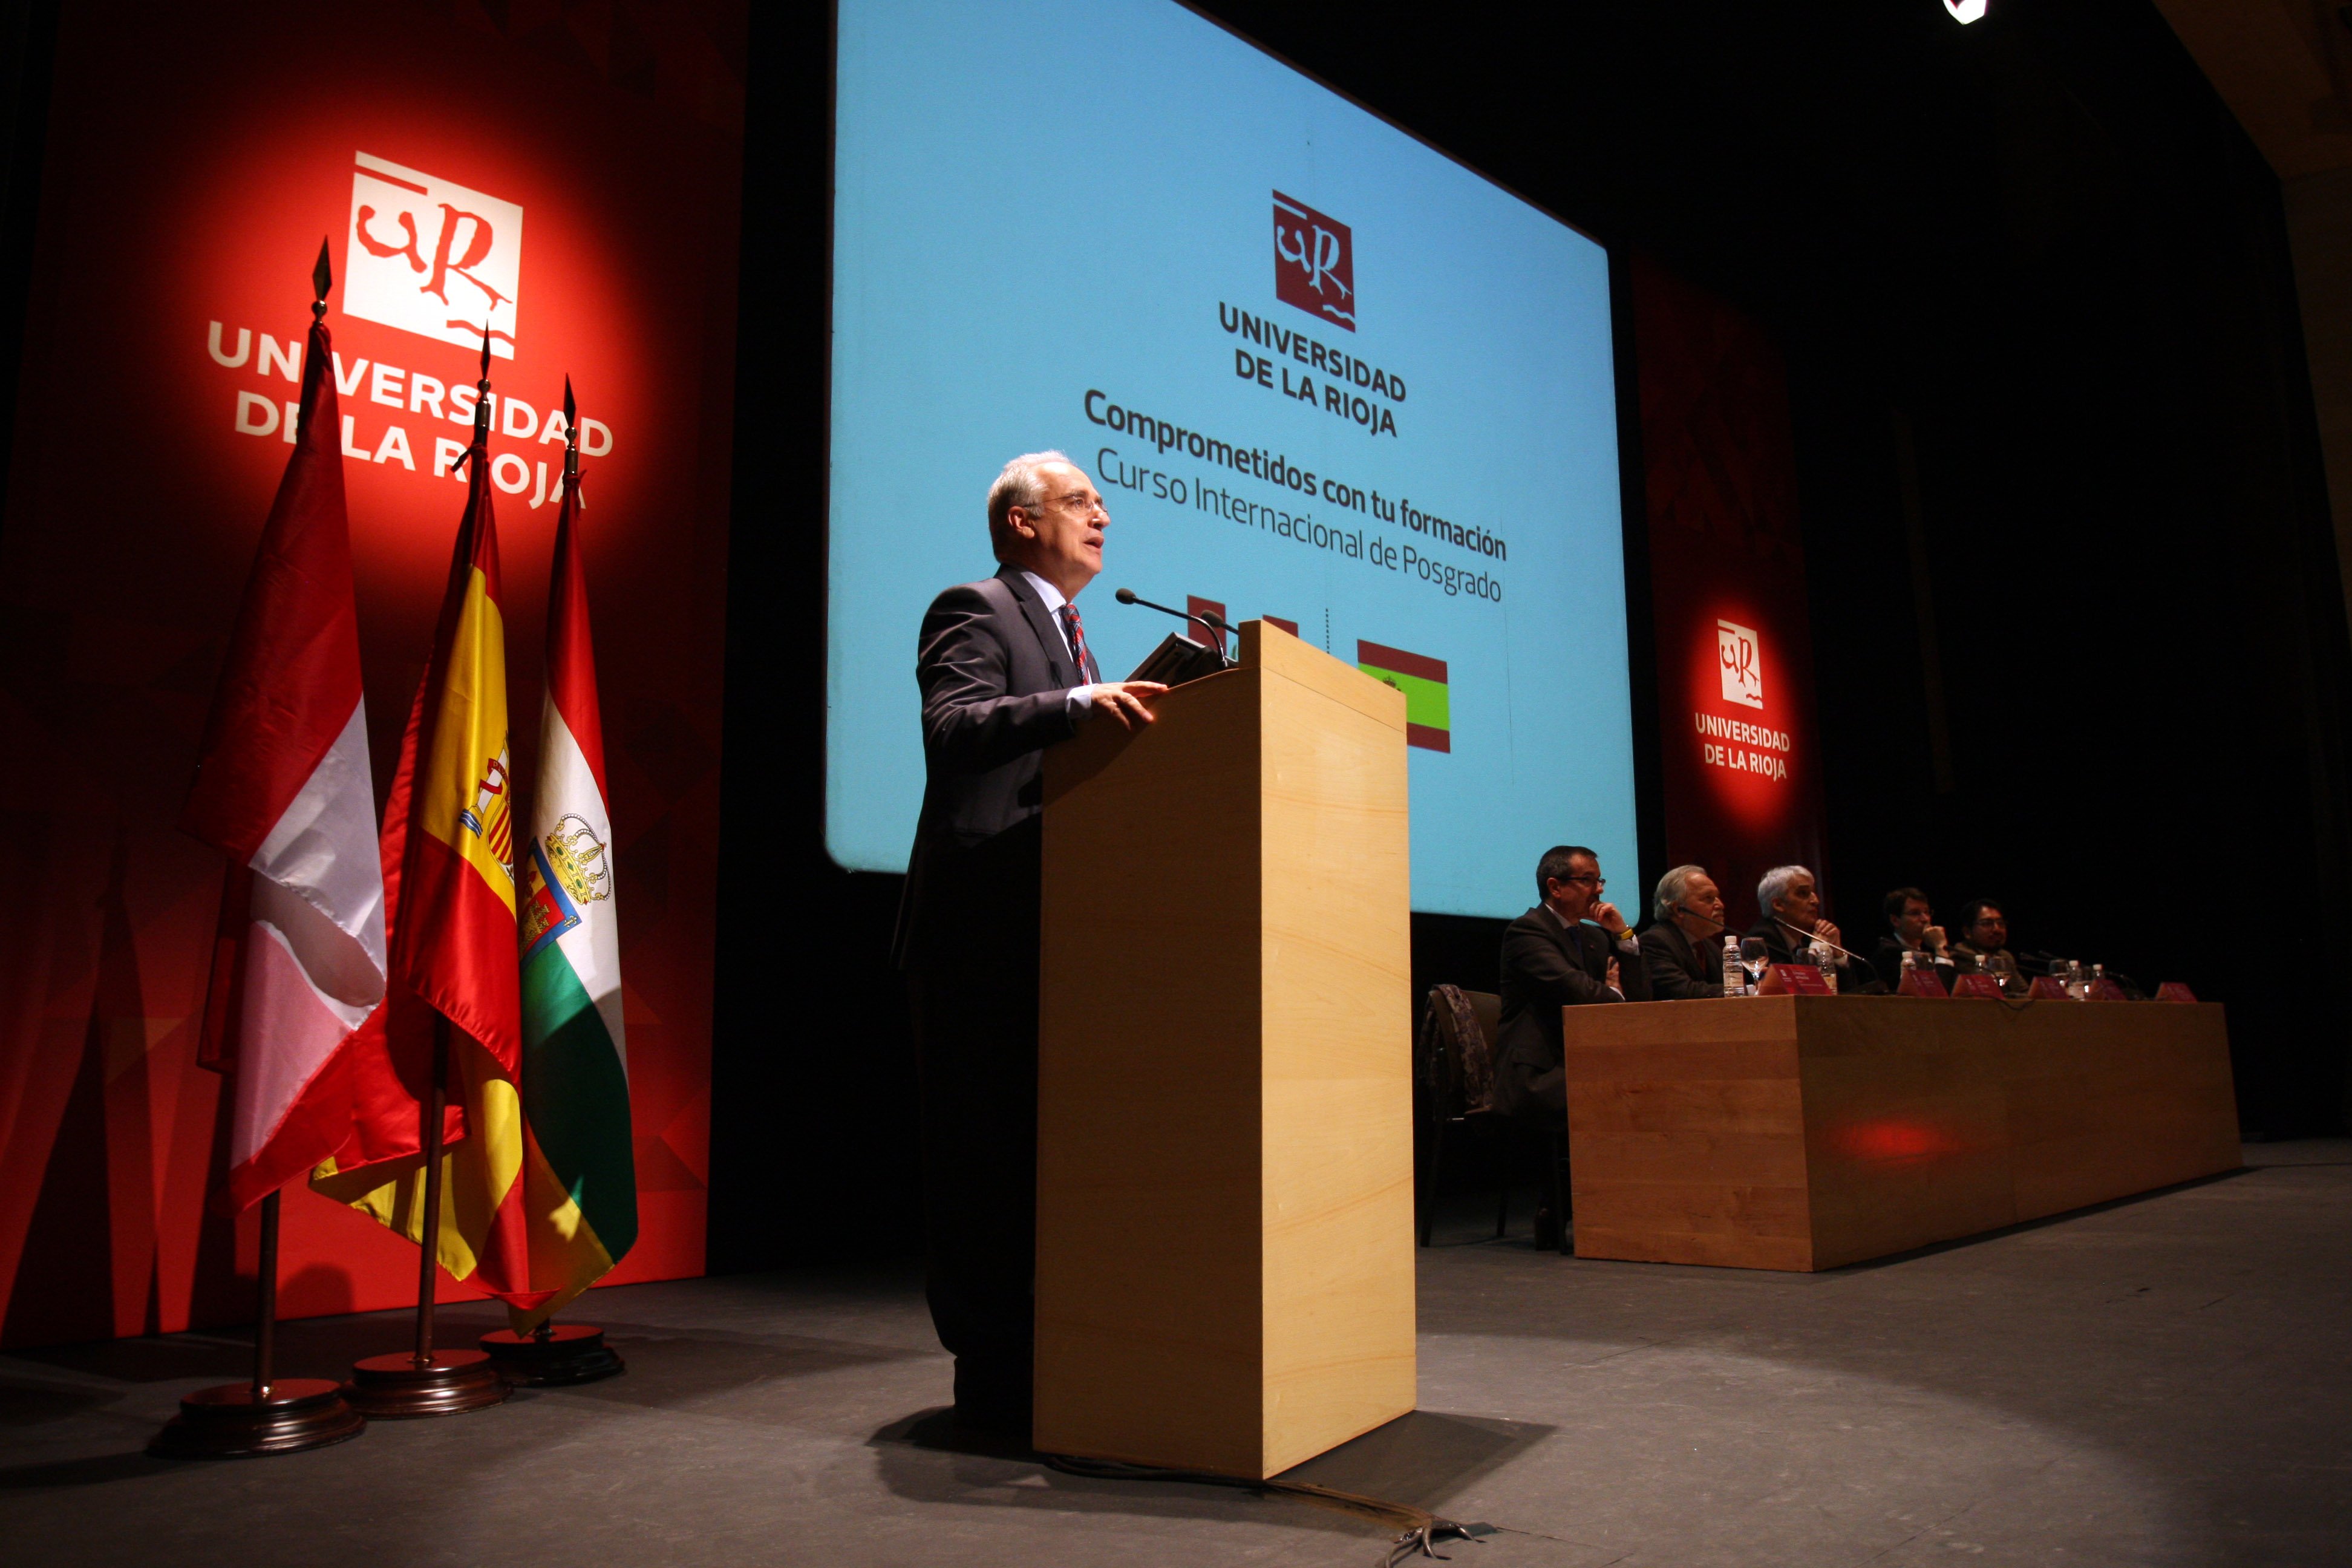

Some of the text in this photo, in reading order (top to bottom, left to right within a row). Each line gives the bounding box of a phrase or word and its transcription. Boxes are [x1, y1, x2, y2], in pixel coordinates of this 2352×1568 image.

[207, 320, 613, 457] UNVERSIDAD
[1219, 301, 1406, 403] UNIVERSIDAD
[1235, 348, 1397, 438] DE LA RIOJA
[340, 414, 416, 472] LA
[433, 436, 587, 510] ROJ
[1083, 388, 1507, 562] Comprometidos con tu formación
[1097, 447, 1502, 604] Curso Internacional de Posgrado
[1694, 712, 1790, 753] UNIVERSIDAD
[1704, 743, 1788, 783] DE LA RIOJA
